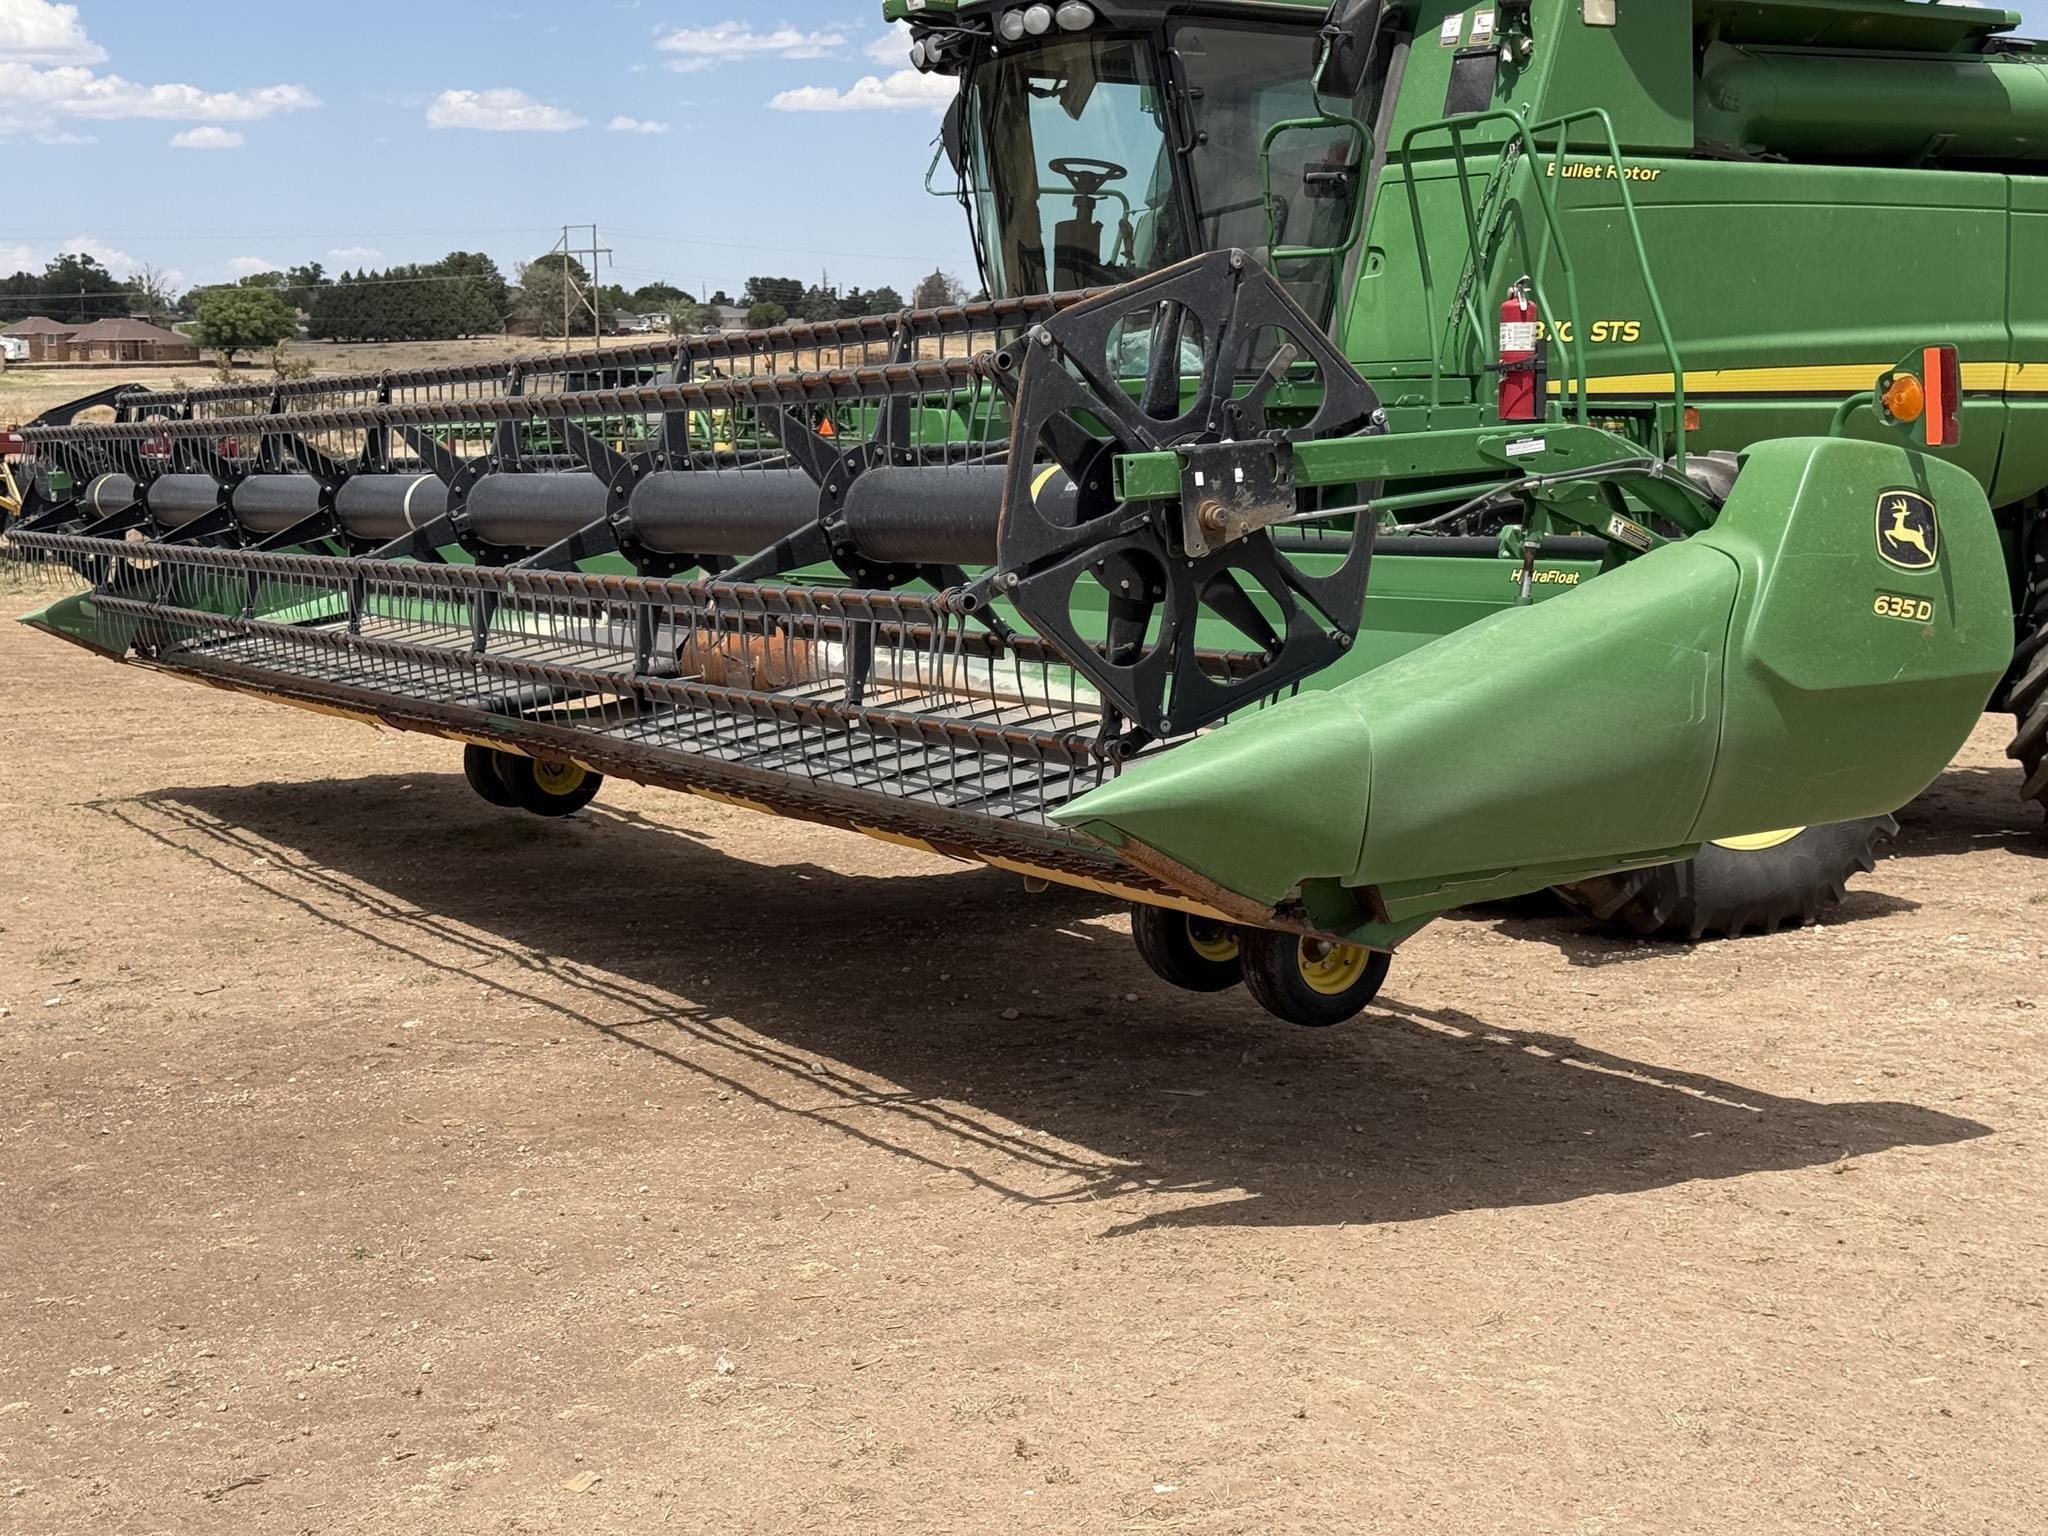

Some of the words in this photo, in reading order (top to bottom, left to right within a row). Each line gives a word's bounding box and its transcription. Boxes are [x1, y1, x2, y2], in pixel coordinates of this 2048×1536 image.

[1590, 321, 1641, 342] STS
[1510, 568, 1580, 584] HraFloat
[1873, 595, 1932, 621] 635D
